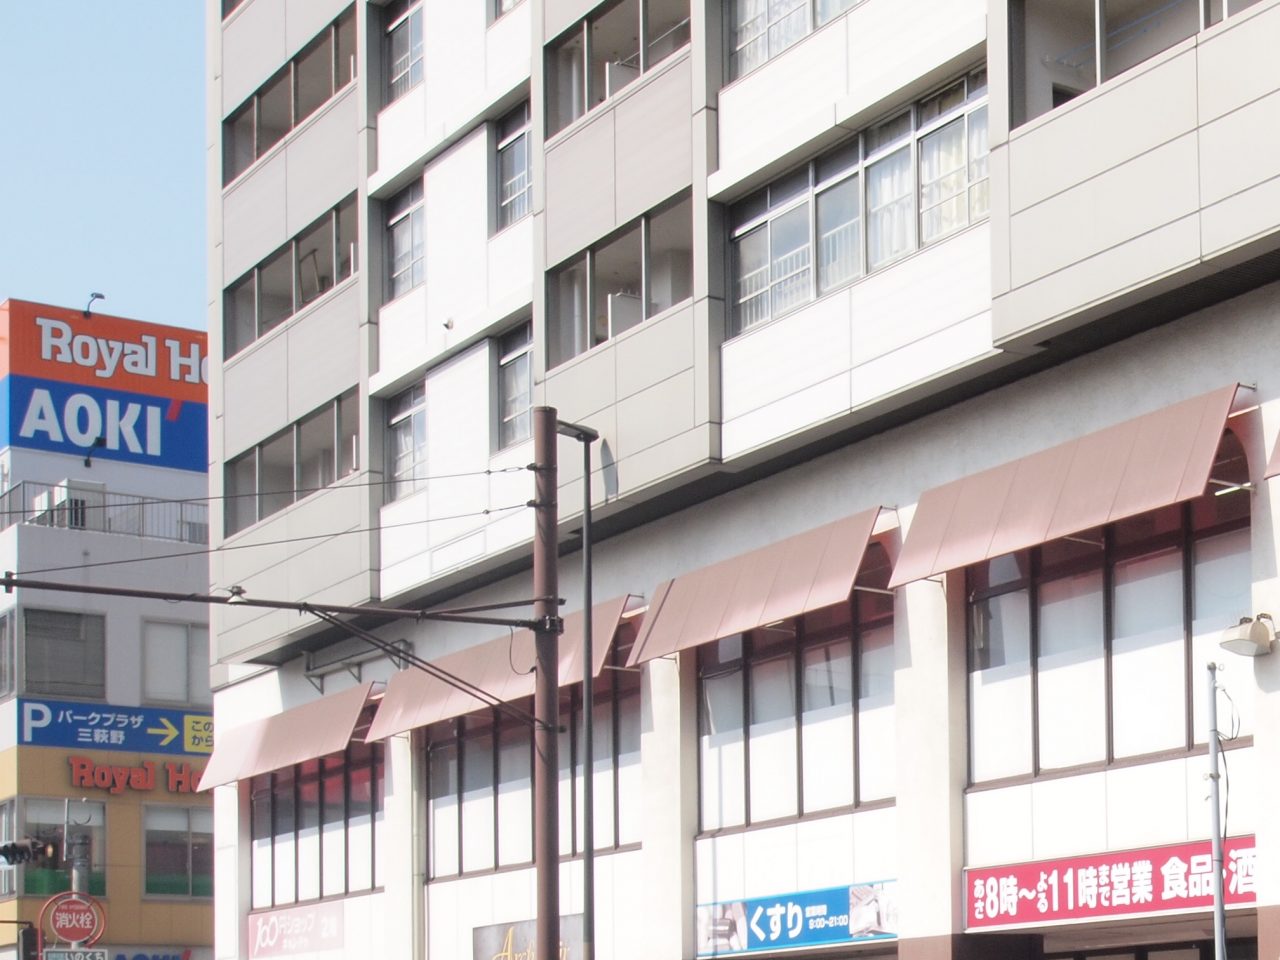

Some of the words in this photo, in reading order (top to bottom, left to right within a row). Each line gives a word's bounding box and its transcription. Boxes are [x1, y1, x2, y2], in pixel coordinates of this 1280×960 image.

[35, 317, 157, 378] Royal
[19, 388, 161, 456] AOKI
[23, 702, 52, 742] P
[77, 728, 125, 744] 三萩野
[69, 756, 155, 794] Royal
[56, 912, 93, 929] 消火栓
[750, 901, 803, 942] くすり
